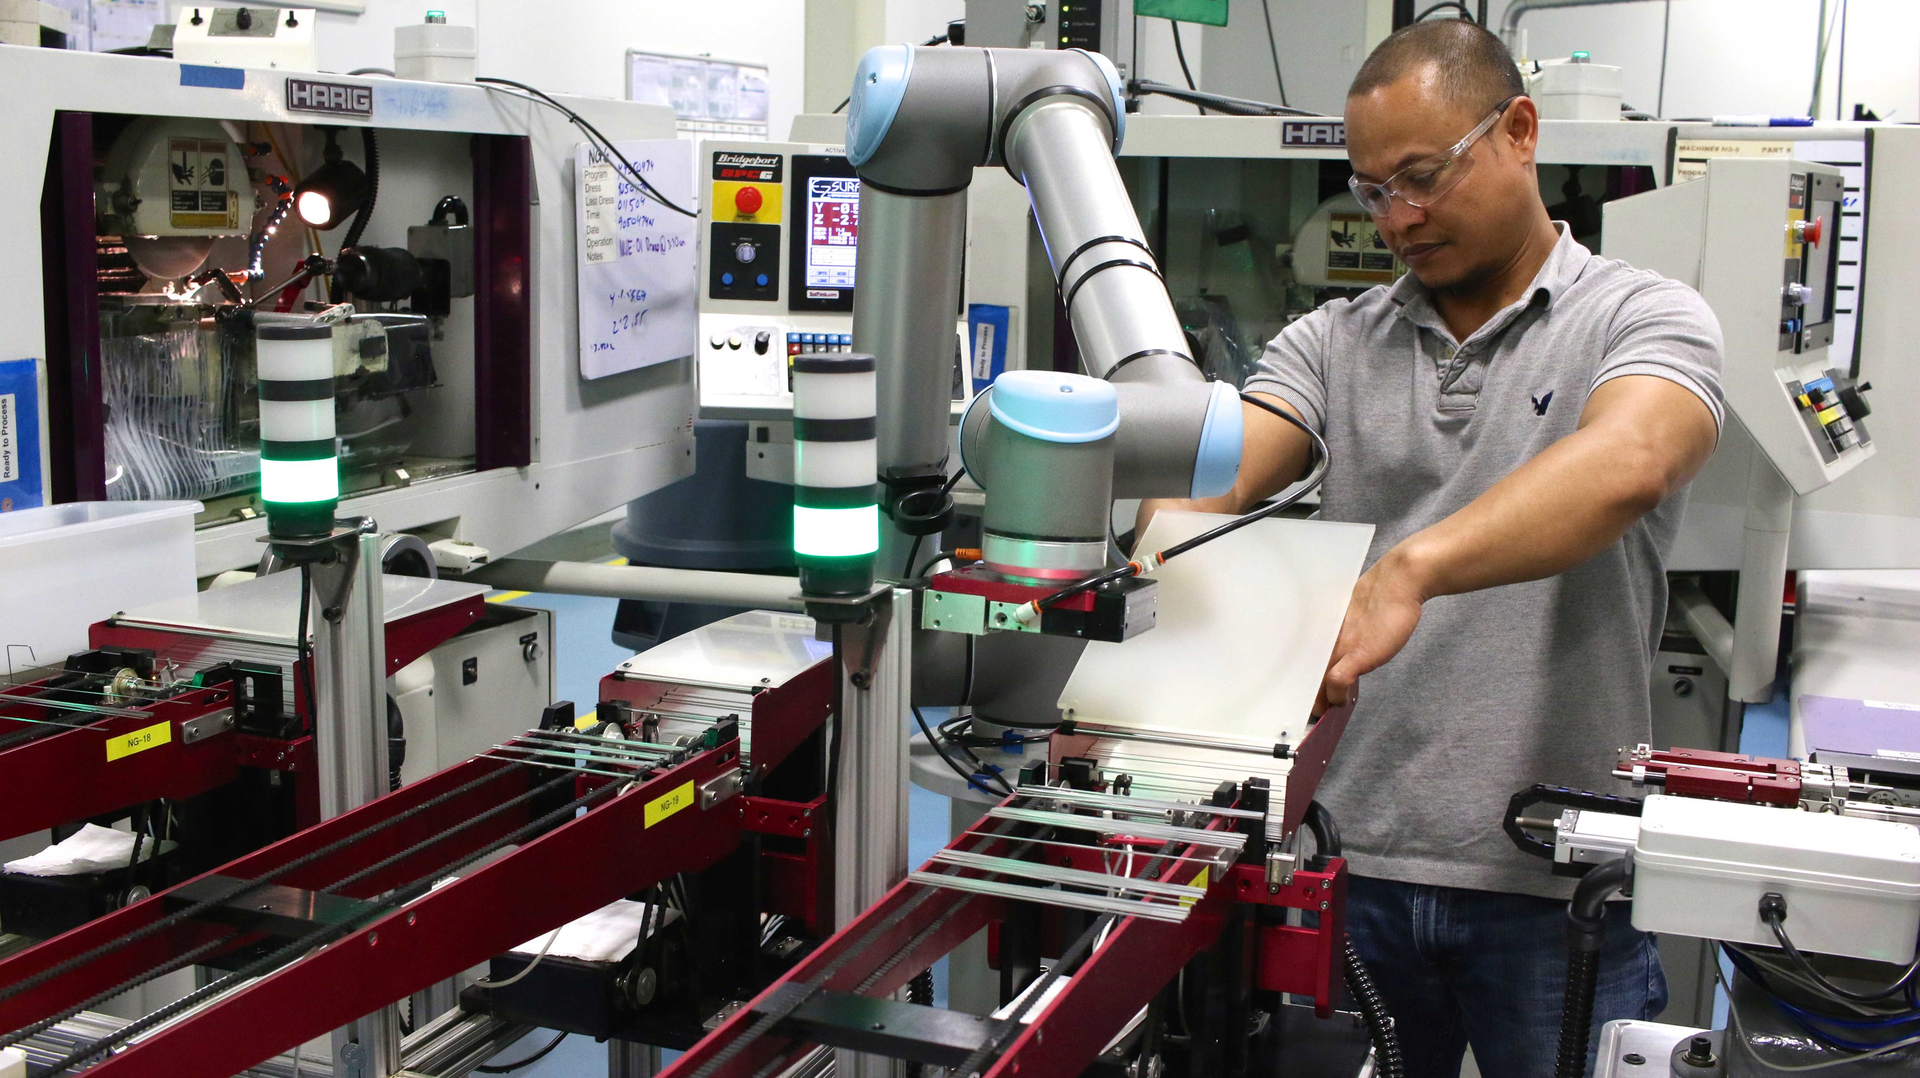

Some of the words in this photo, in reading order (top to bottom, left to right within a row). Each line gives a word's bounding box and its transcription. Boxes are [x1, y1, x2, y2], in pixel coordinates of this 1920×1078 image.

[292, 82, 370, 111] HARIG
[717, 153, 779, 168] Bridgeport
[584, 170, 608, 181] Program
[720, 168, 774, 180] BPCG
[585, 183, 601, 193] Dress
[586, 197, 598, 206] Last
[599, 196, 614, 205] Dress
[814, 202, 824, 213] Y
[586, 210, 600, 220] Time
[814, 213, 824, 225] Z
[586, 225, 600, 235] Date
[586, 237, 613, 248] Operation
[586, 252, 604, 261] Notes:
[3, 438, 9, 447] to
[127, 733, 152, 748] NG-18
[660, 794, 680, 812] NG-19
